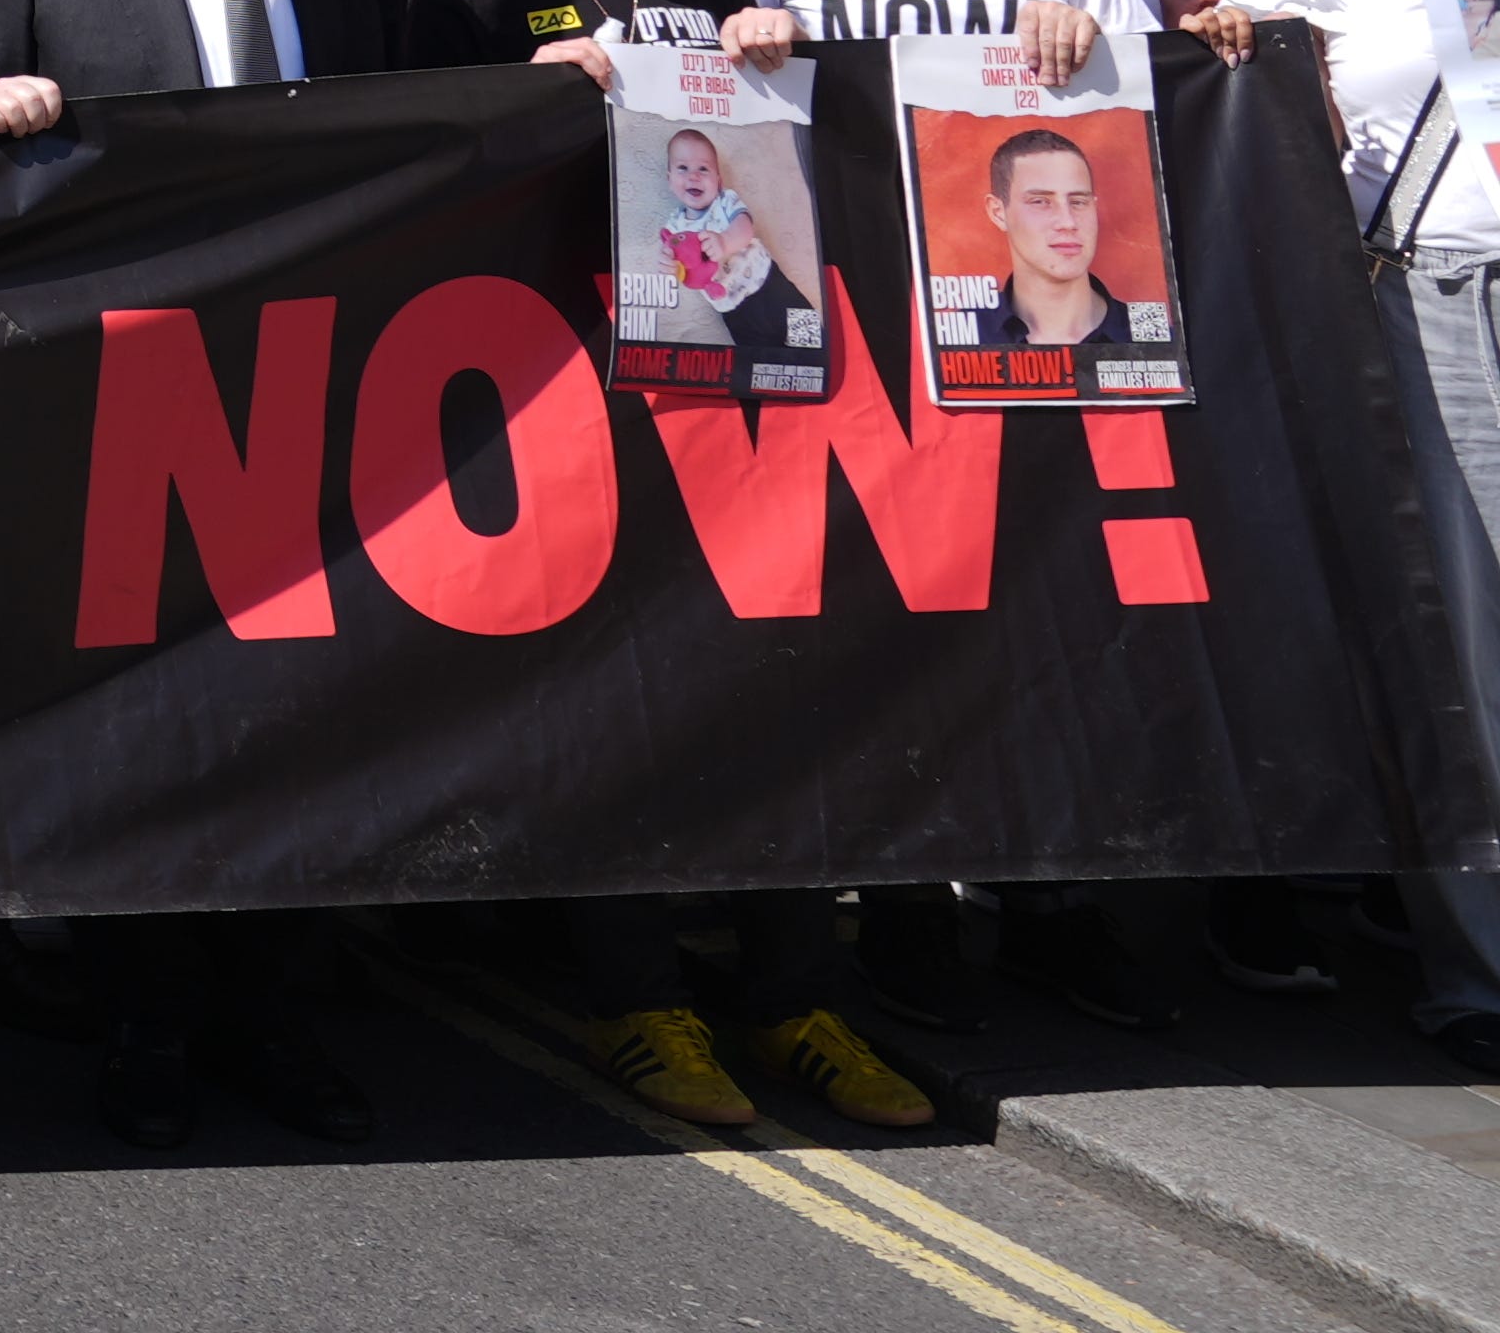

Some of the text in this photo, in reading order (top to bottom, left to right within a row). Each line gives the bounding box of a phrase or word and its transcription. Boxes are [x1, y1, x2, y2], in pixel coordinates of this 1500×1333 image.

[531, 7, 577, 30] 240
[680, 74, 736, 95] KFIR BIBAS
[982, 68, 1017, 87] OMER
[1014, 89, 1040, 110] (22)
[618, 273, 680, 309] BRING
[929, 275, 999, 310] BRING
[618, 306, 657, 341] HIM
[934, 311, 980, 346] HIM
[616, 347, 733, 384] HOME NOW!
[750, 374, 790, 392] FAMILIES
[940, 347, 1075, 386] HOME NOW!
[1097, 370, 1183, 389] FAMILIES FORUM
[73, 263, 1212, 649] NOW!
